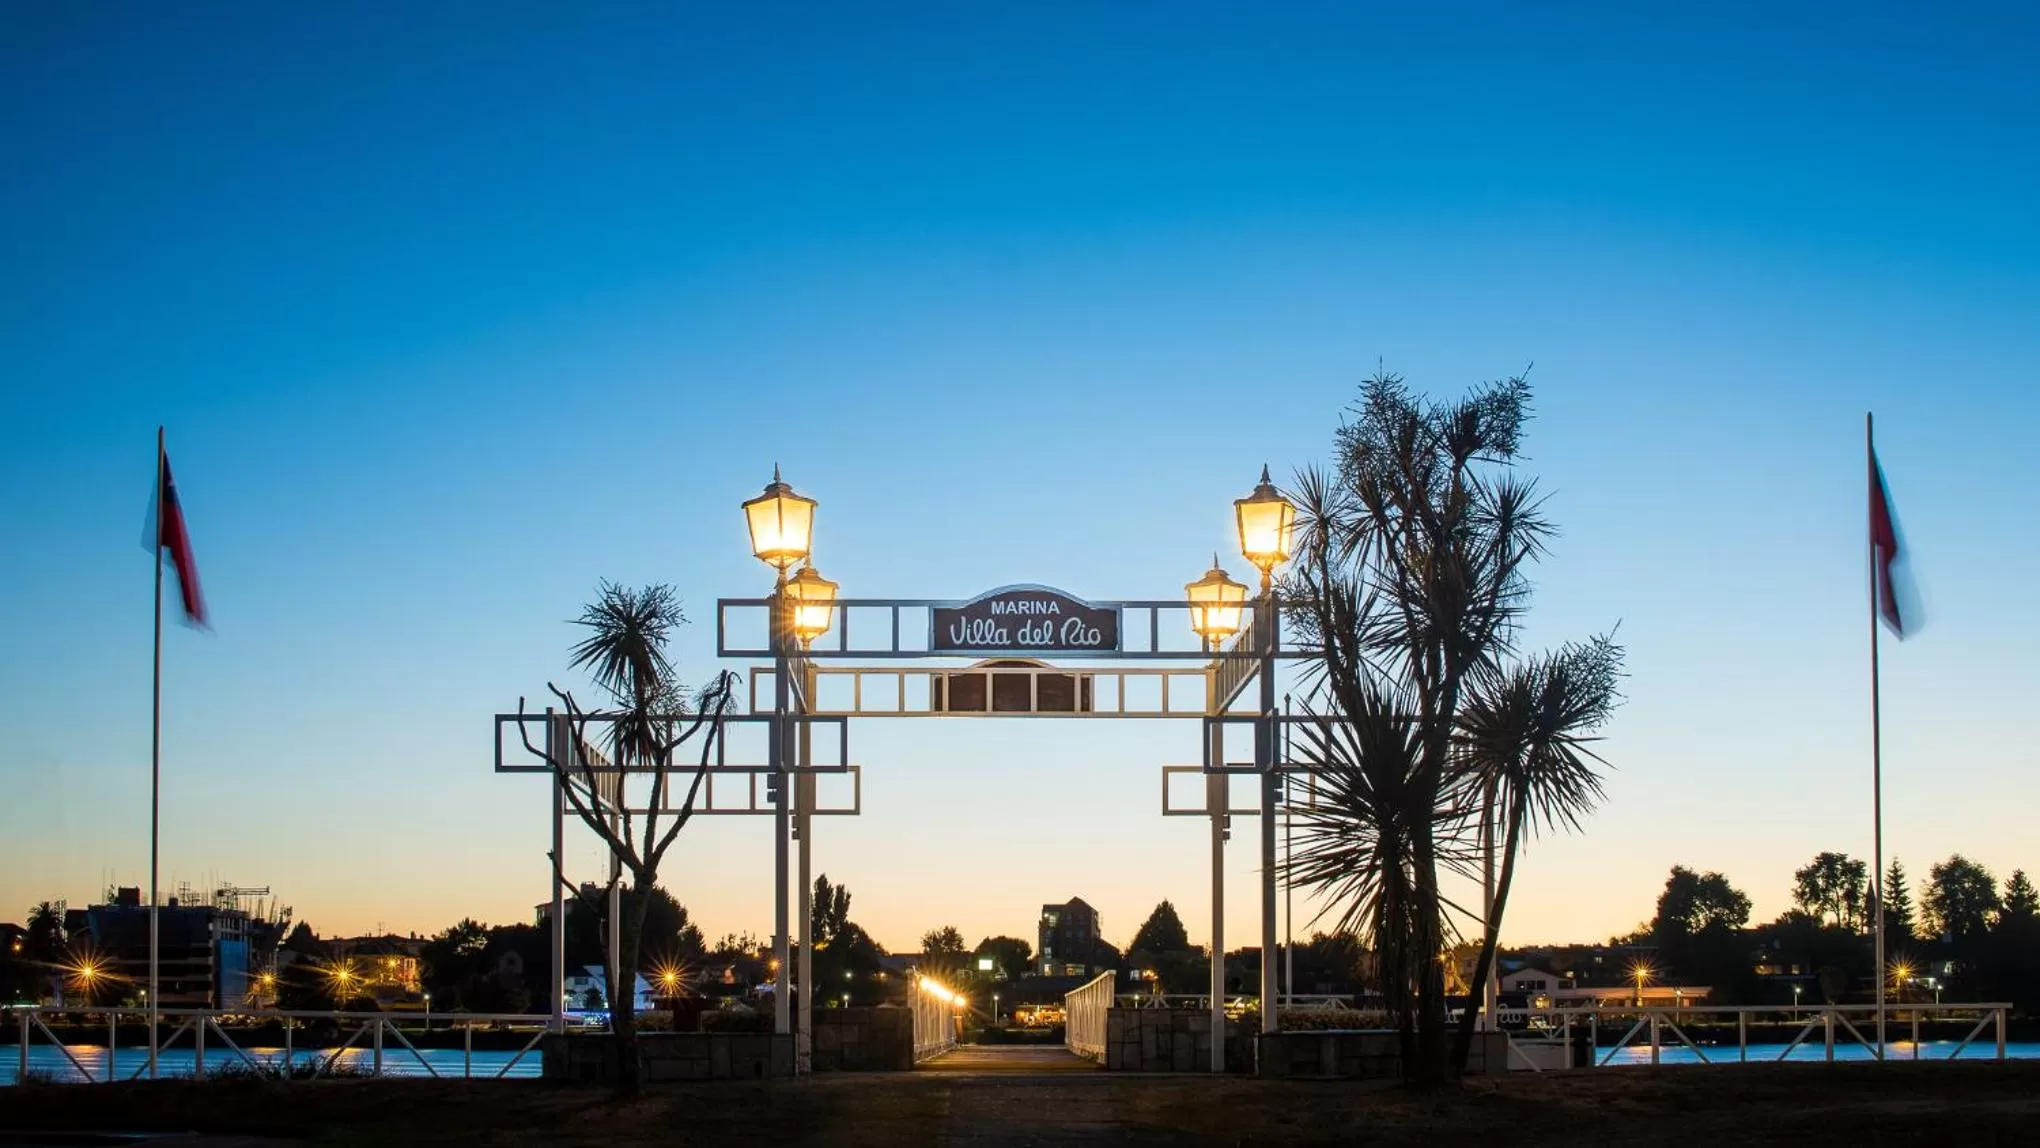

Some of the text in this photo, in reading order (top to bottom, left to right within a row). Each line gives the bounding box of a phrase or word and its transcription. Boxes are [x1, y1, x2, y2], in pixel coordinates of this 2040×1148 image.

[992, 601, 1060, 614] MARINA
[950, 616, 1101, 645] Villa del Rio
